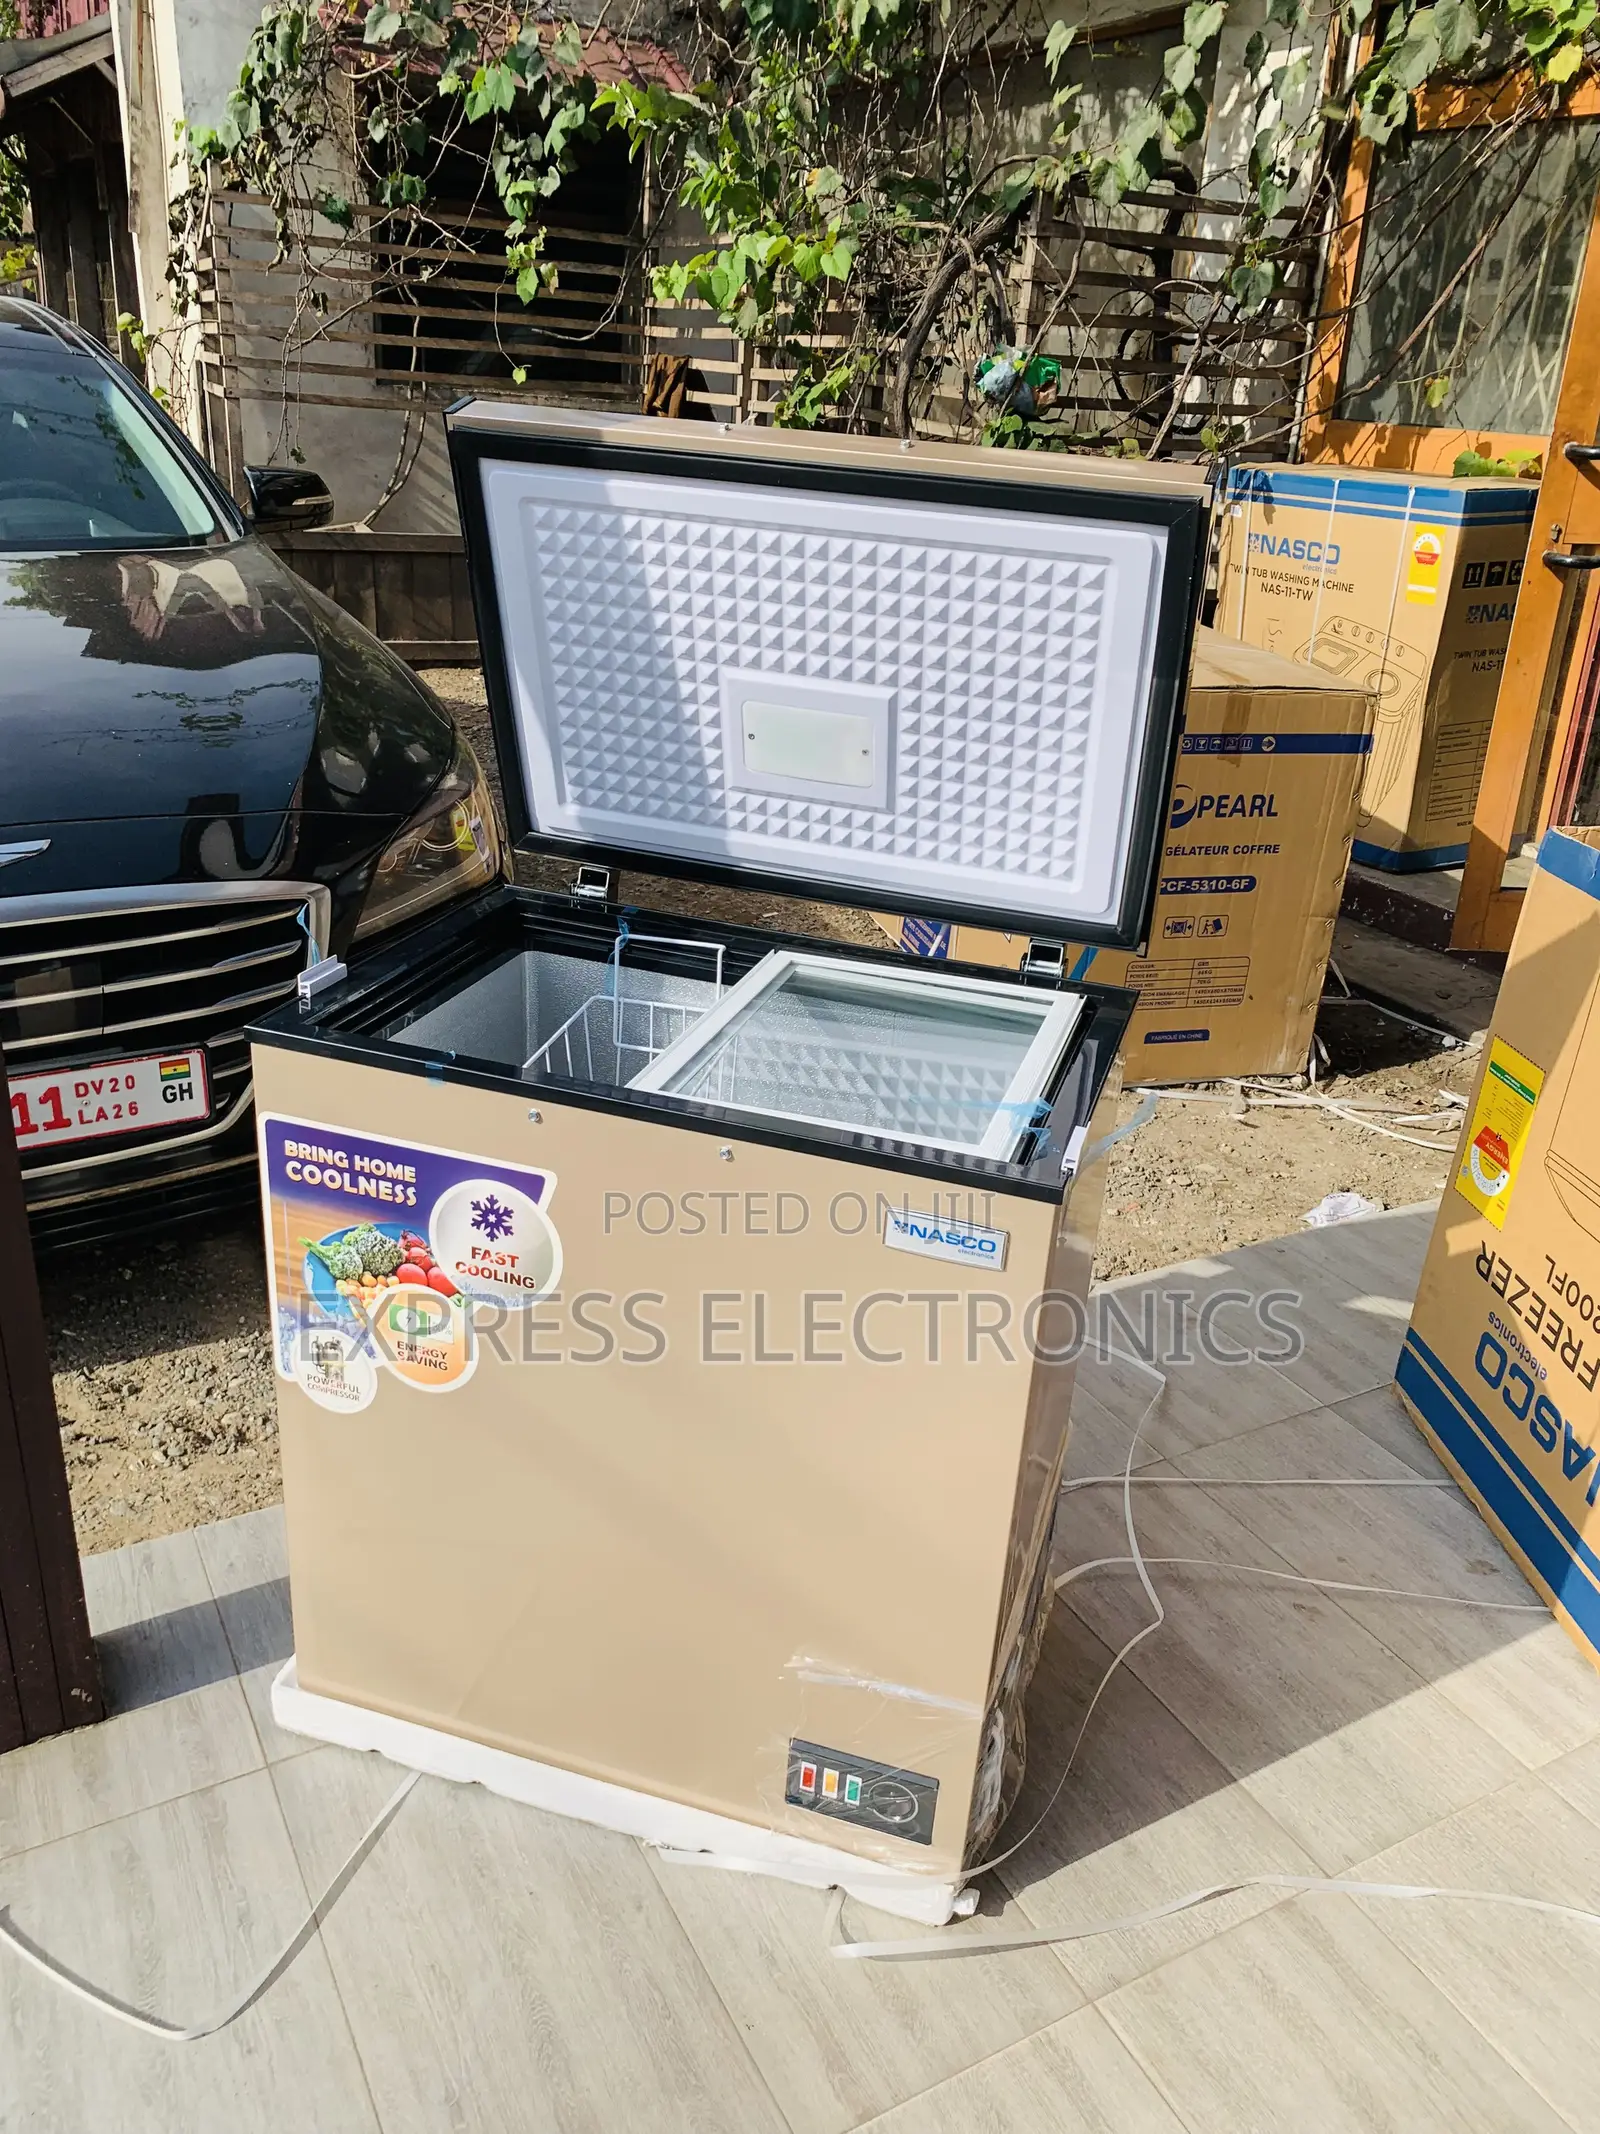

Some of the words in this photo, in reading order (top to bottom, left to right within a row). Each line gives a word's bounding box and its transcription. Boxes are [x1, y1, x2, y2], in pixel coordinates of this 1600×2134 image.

[1260, 534, 1341, 565] NASCO
[1252, 567, 1268, 579] TUB
[1270, 570, 1310, 586] WASHING
[1260, 582, 1314, 601] NAS-11-TW
[1474, 649, 1487, 657] TUB
[1197, 794, 1279, 818] PEARL
[1232, 844, 1281, 855] COFFRE
[74, 1075, 136, 1098] DV20
[162, 1082, 194, 1104] GH
[78, 1101, 139, 1125] LA26
[284, 1139, 349, 1168] BRING
[354, 1155, 417, 1183] HOME
[285, 1161, 417, 1207] COOLNESS
[910, 1224, 996, 1253] NASCO
[471, 1246, 520, 1268] FAST
[958, 1248, 995, 1260] electronics
[455, 1261, 535, 1289] COOLING
[1475, 1240, 1600, 1392] FREEZER
[397, 1340, 448, 1360] ENERGY
[1488, 1311, 1548, 1381] electronics
[397, 1351, 448, 1371] SAVING
[307, 1374, 361, 1394] POWERFUL
[307, 1383, 360, 1401] COMPRESSOR
